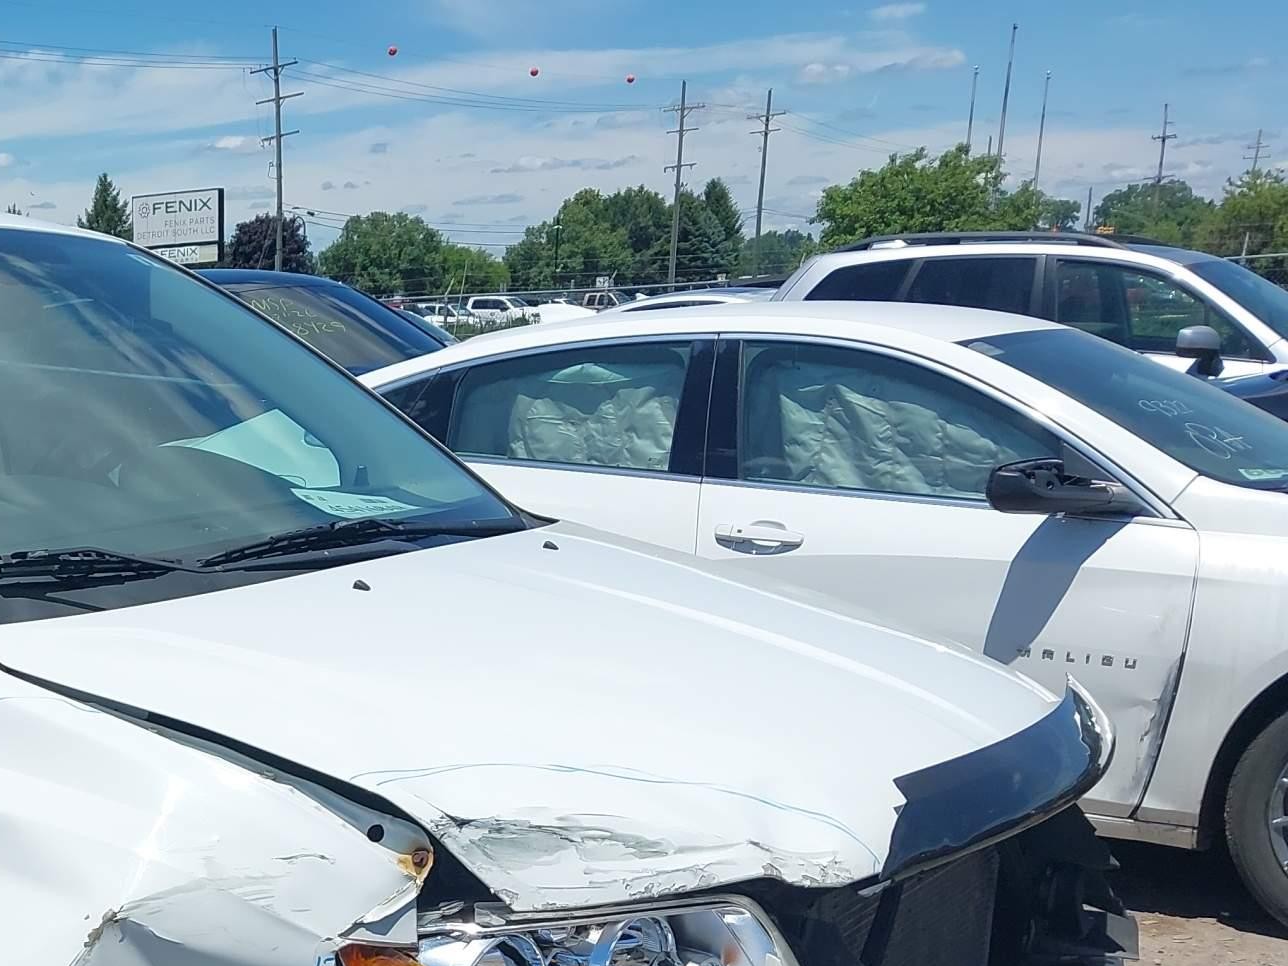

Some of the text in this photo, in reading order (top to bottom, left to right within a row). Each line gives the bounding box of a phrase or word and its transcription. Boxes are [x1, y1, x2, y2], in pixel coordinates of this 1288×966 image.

[152, 197, 212, 215] FENIX
[189, 217, 215, 226] PARTS
[137, 226, 215, 241] DETROIT SOUTH LLC
